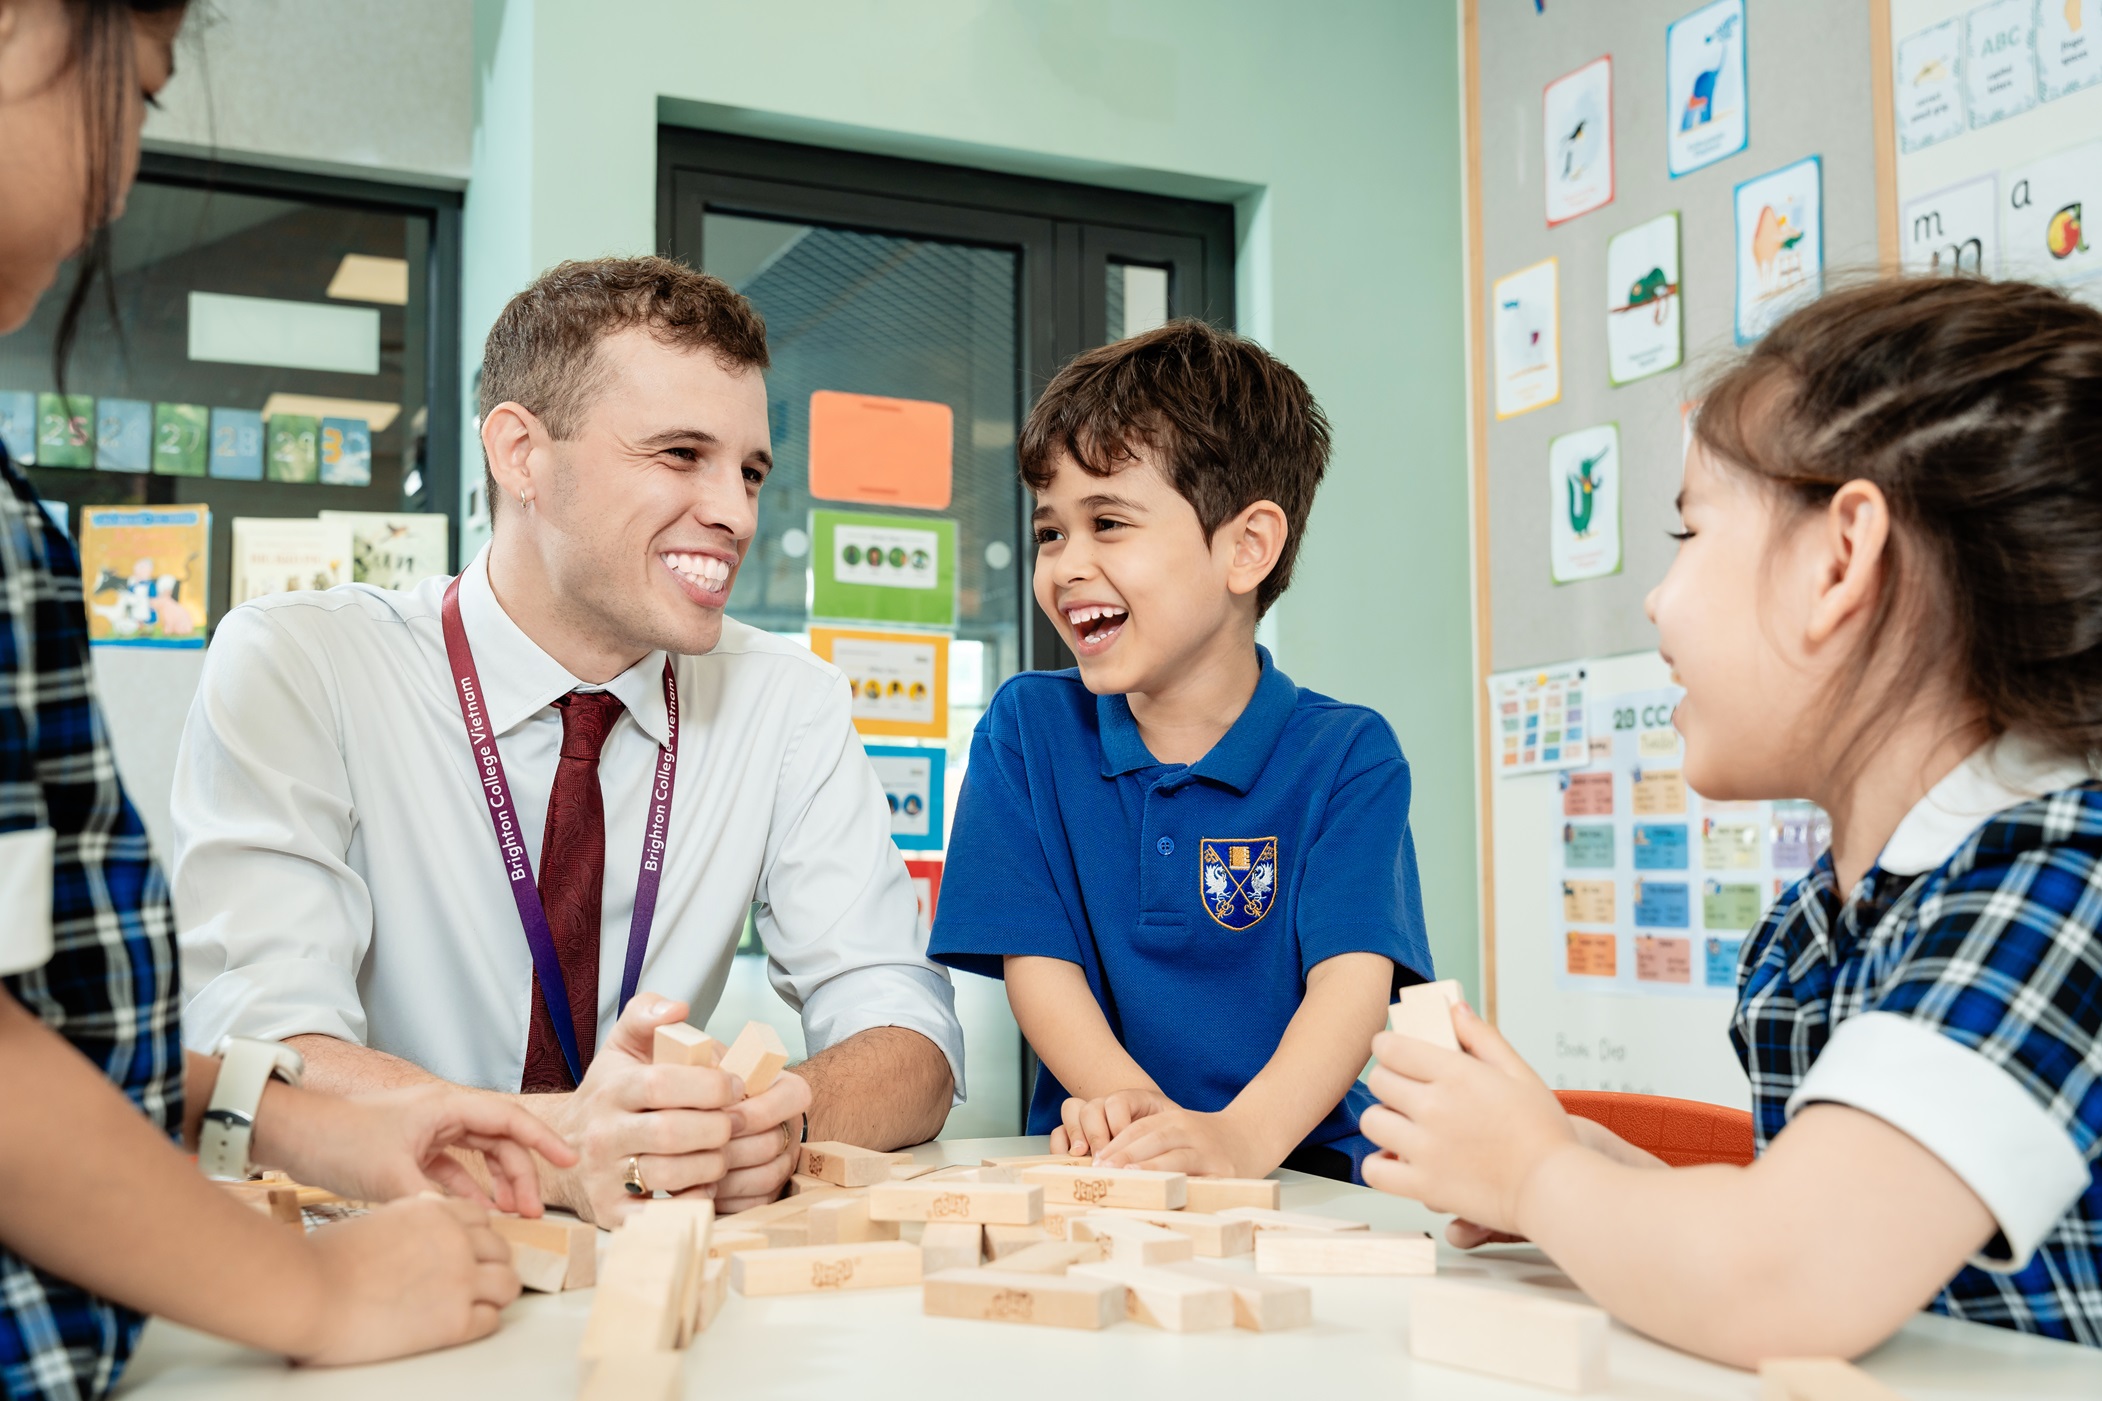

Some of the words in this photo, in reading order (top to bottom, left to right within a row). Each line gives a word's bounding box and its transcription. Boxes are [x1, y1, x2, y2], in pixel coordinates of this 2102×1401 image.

[1981, 25, 2021, 58] ABC
[2011, 178, 2033, 210] a
[1914, 210, 1944, 242] m
[41, 415, 89, 447] 25
[158, 423, 201, 455] 27
[214, 426, 257, 457] 28
[273, 431, 316, 463] 29
[460, 676, 487, 745] Vietnam
[1642, 704, 1674, 728] CC
[480, 746, 505, 808] College
[644, 804, 666, 872] Brighton
[655, 743, 676, 801] College
[668, 677, 676, 738] Vietnam
[498, 810, 526, 882] Brighton
[1073, 1179, 1108, 1203] Jenga
[811, 1258, 854, 1289] Jenga
